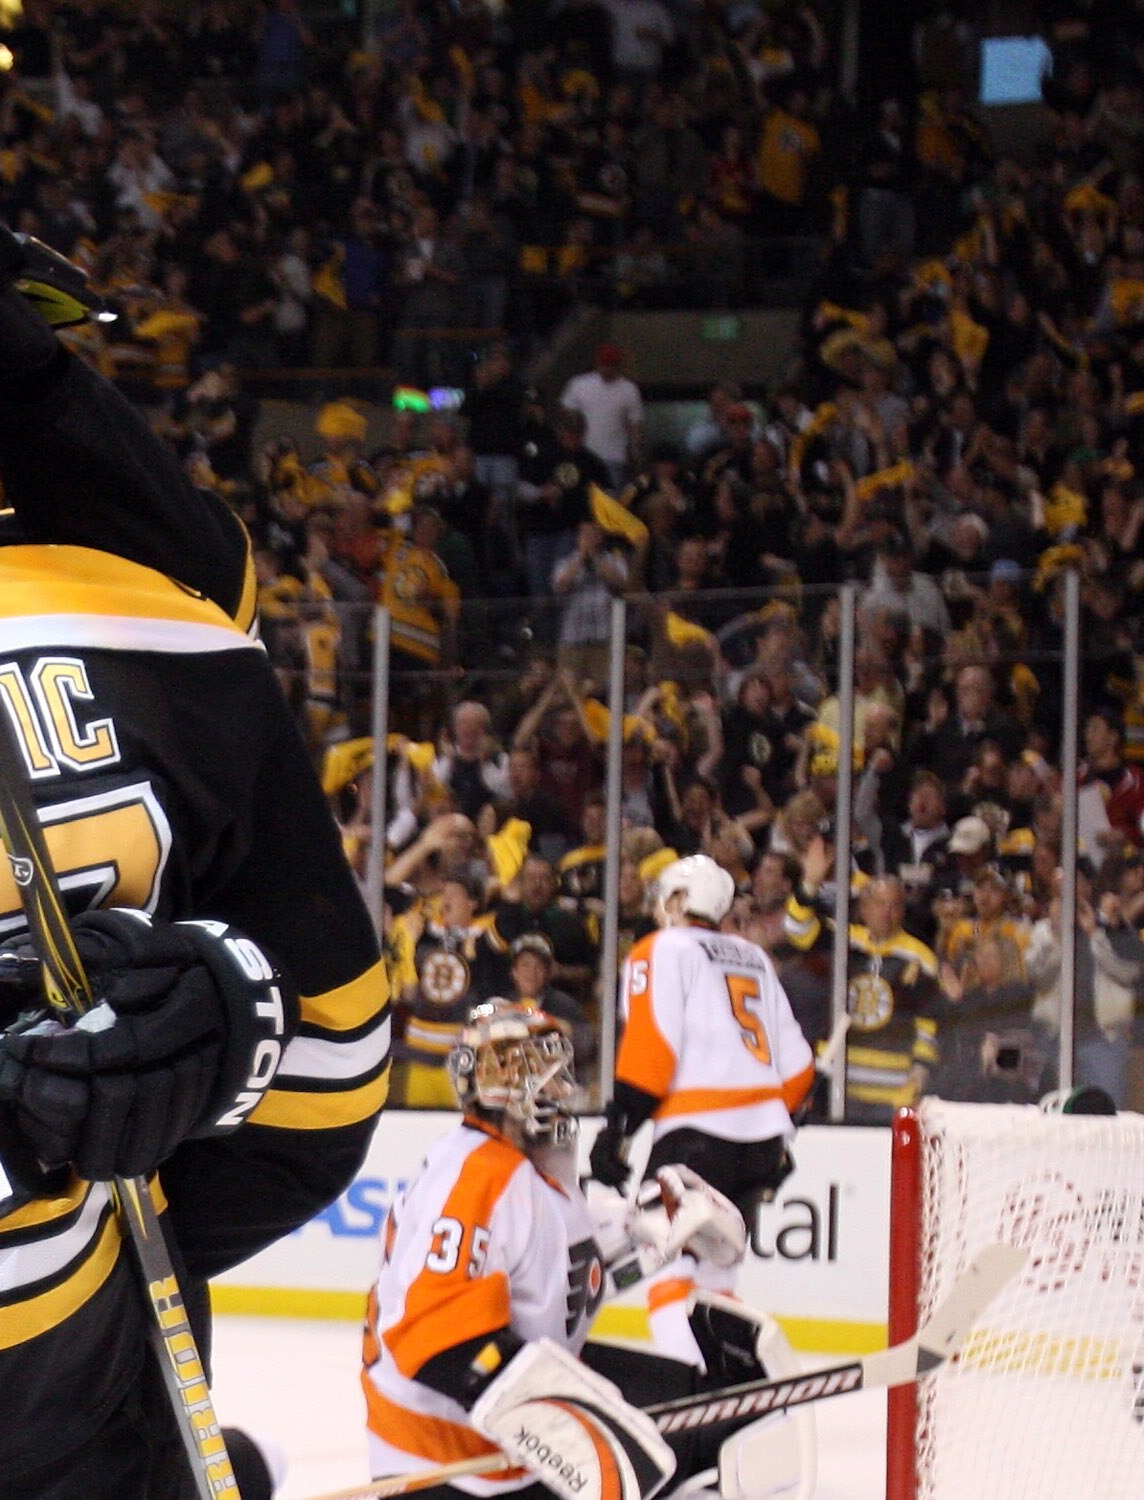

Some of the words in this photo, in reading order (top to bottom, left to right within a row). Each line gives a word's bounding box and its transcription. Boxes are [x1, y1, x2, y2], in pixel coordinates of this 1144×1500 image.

[725, 972, 772, 1066] 5
[426, 1216, 491, 1281] 35
[512, 1424, 588, 1493] Reebok
